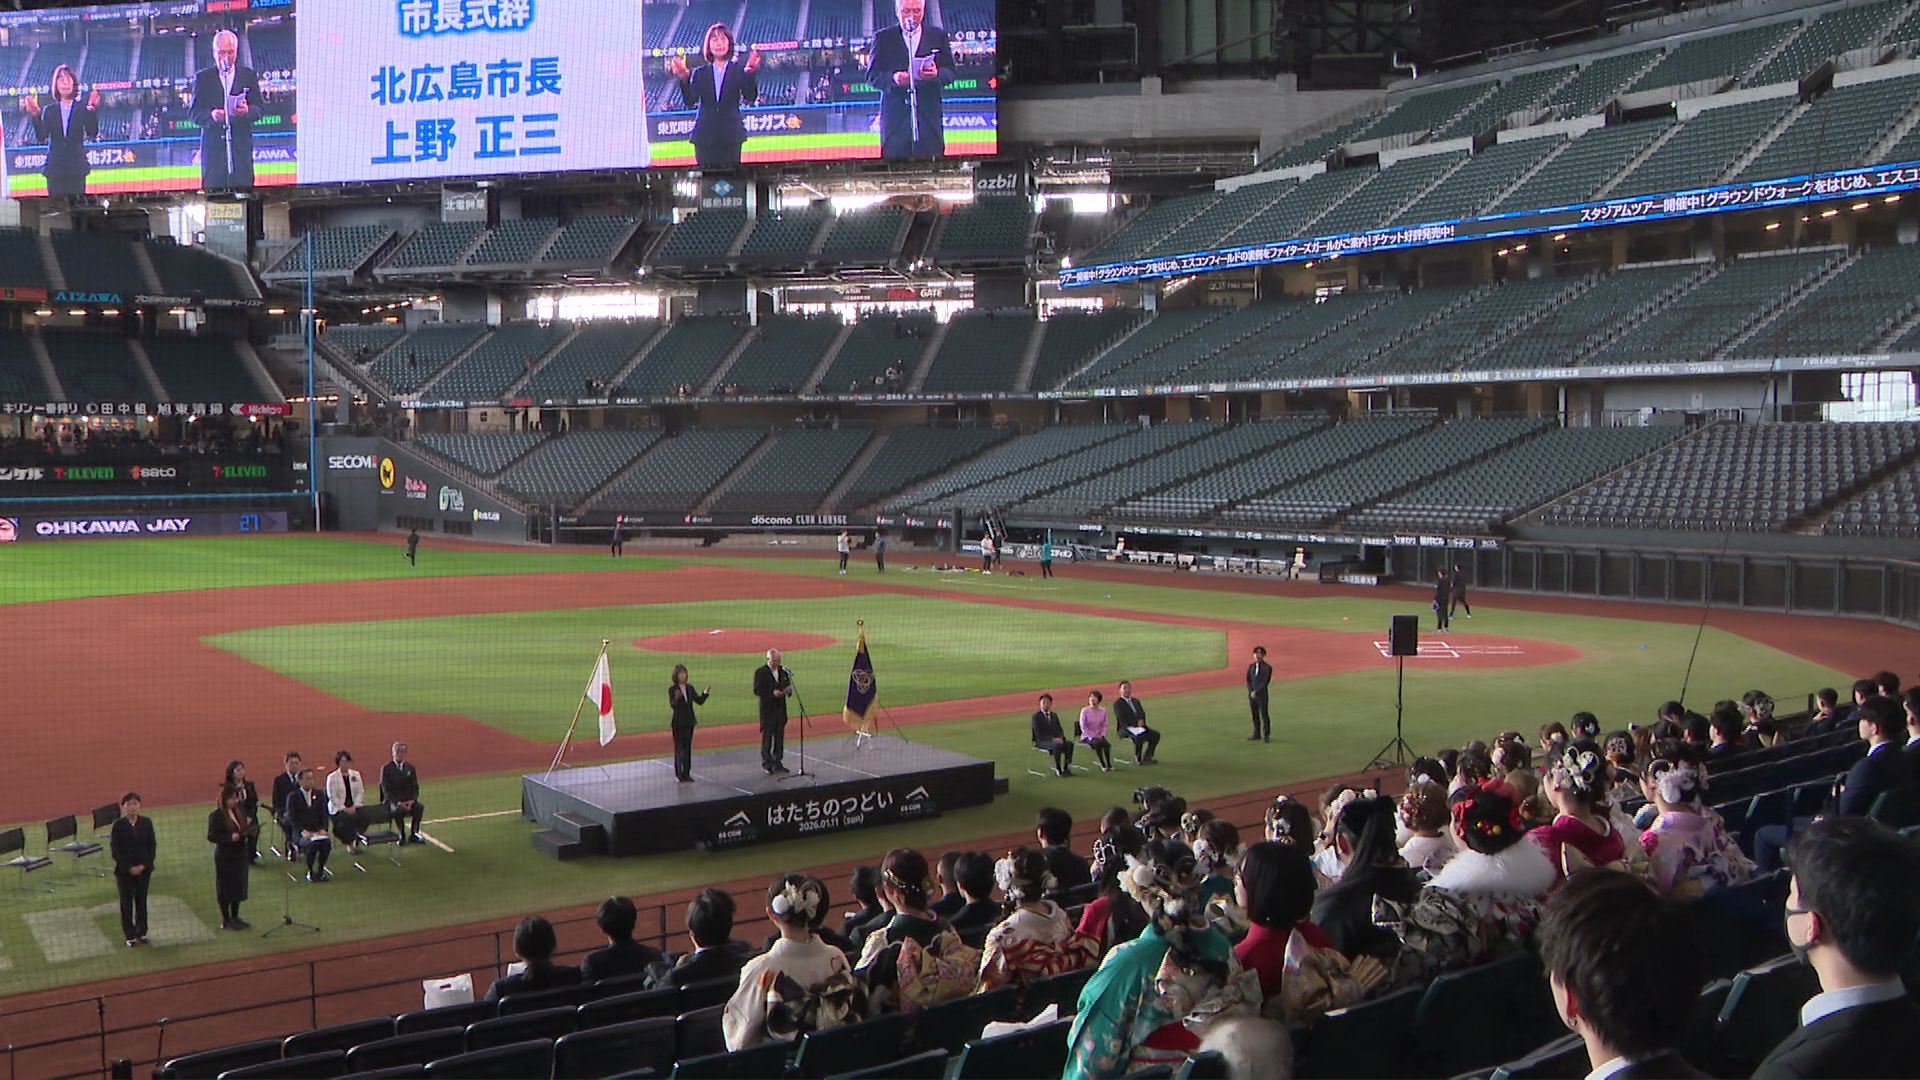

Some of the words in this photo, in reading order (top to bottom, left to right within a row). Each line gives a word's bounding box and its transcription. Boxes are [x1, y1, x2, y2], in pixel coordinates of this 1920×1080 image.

[401, 0, 531, 34] 市長式辞
[371, 56, 562, 105] 北広島市長
[742, 113, 788, 132] 北ガス
[371, 117, 457, 165] 上野
[474, 113, 562, 159] 正三
[977, 173, 1018, 190] azbil
[1580, 168, 1920, 222] スタジアムツアー開催中!グラウンドウォークをはじめ、エスコ
[55, 291, 122, 303] AIZAWA
[919, 288, 943, 298] GATE
[3, 403, 79, 415] キリン一番搾り
[101, 403, 147, 415] 田中組
[328, 455, 372, 469] SECOM
[54, 466, 115, 480] 7-ELEVEN
[140, 467, 176, 478] sato
[212, 465, 267, 478] 7-ELEVEN
[36, 518, 140, 536] OHKAWA
[146, 518, 192, 533] JAY
[239, 513, 260, 532] 27
[751, 514, 793, 525] docomo
[795, 514, 817, 525] CLUB
[818, 514, 848, 525] LOUNGE
[766, 790, 895, 826] はたちのつどい
[798, 817, 839, 832] 2026.01.11
